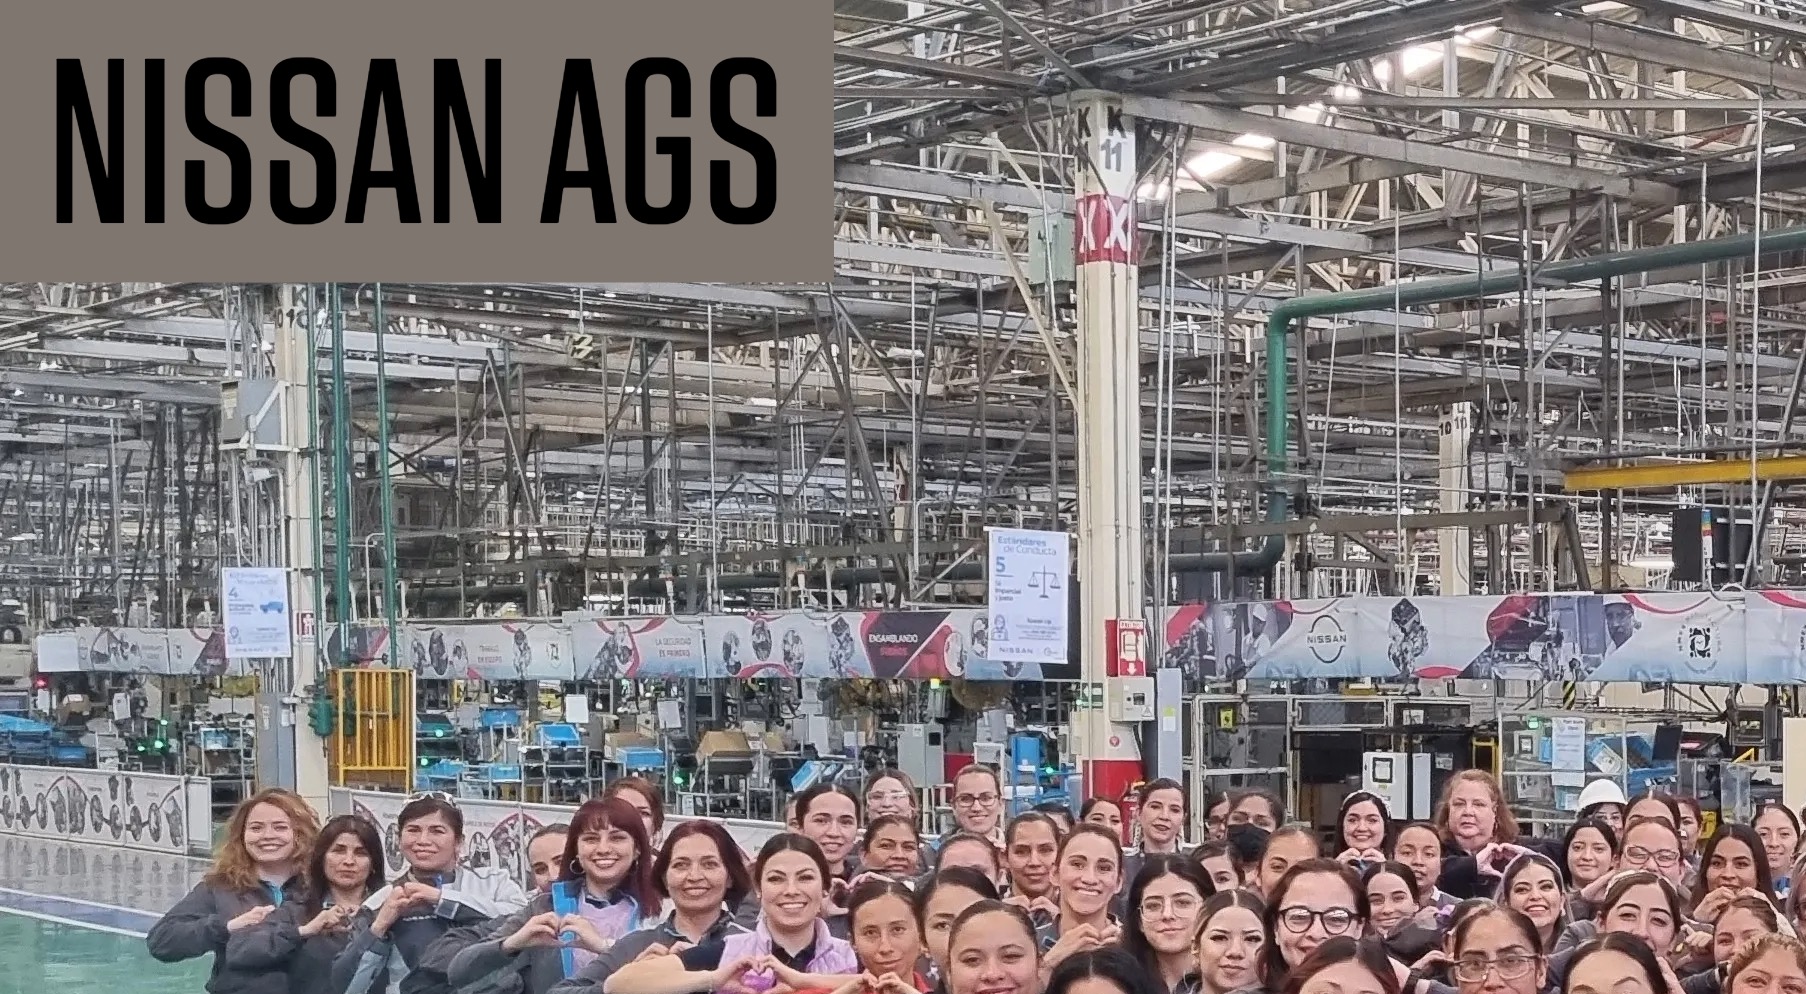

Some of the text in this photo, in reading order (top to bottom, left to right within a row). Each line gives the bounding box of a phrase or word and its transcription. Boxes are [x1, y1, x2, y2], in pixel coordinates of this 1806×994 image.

[1078, 106, 1091, 138] K
[1107, 105, 1126, 138] K
[1101, 138, 1122, 172] 11
[995, 556, 1006, 573] 5
[1307, 634, 1347, 644] NISSAN
